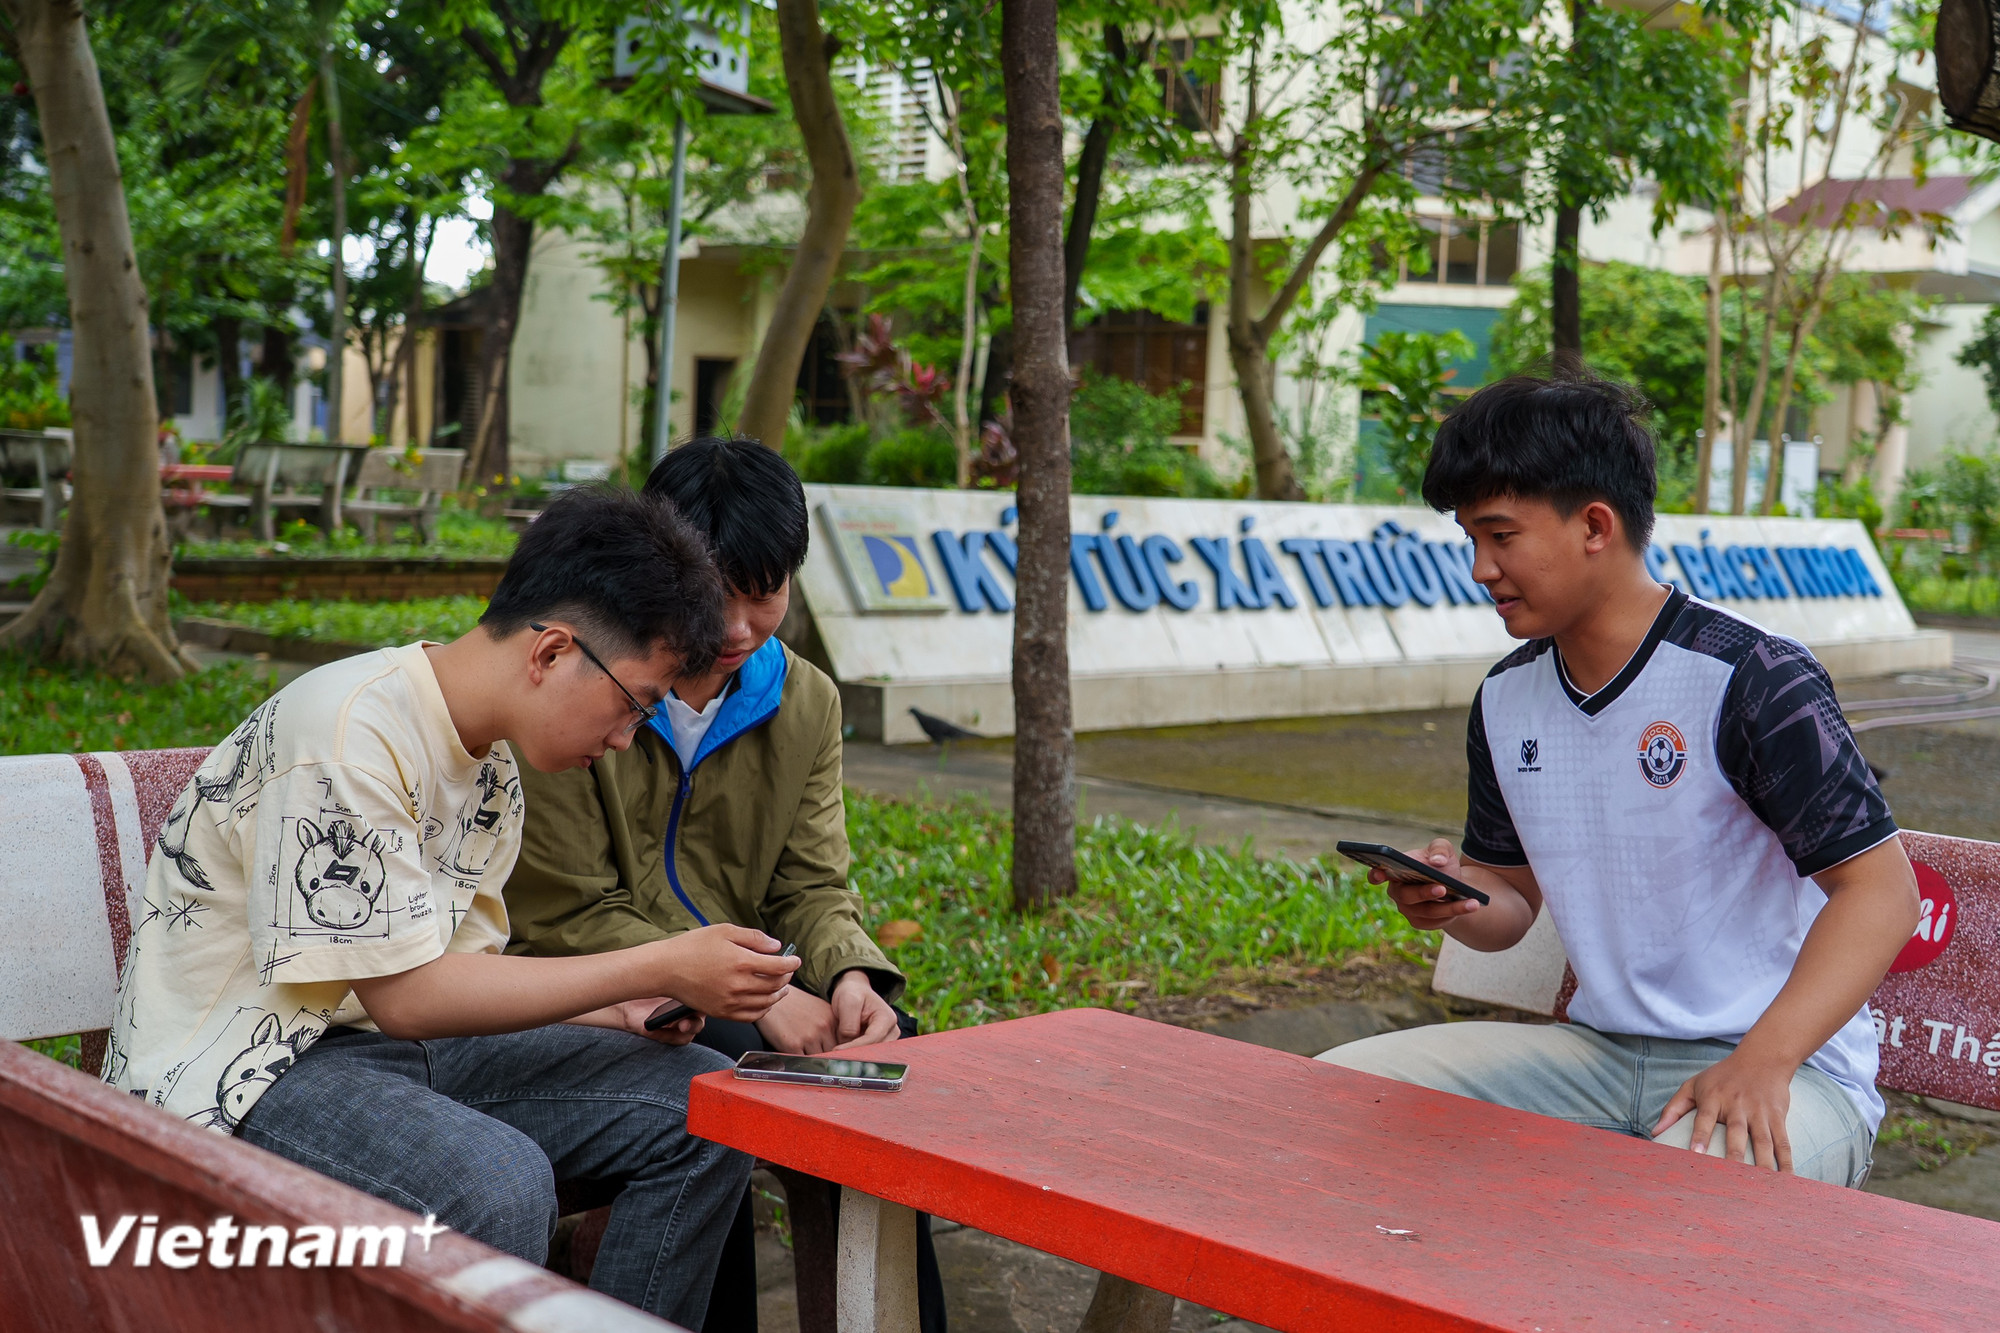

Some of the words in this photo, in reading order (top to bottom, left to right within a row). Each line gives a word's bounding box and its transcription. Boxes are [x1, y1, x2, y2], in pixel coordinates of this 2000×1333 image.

[1070, 509, 1199, 612] TÚC
[1189, 514, 1299, 610] XÁ
[1279, 520, 1496, 609] TRƯỜN
[1673, 529, 1790, 599] BÁCH
[1775, 545, 1883, 597] KHOA
[1645, 727, 1678, 741] SOCCER
[335, 802, 352, 814] 5cm
[268, 863, 278, 886] 25cm
[454, 880, 477, 891] 18cm
[329, 935, 354, 945] 18cm
[163, 1060, 186, 1083] 25cm
